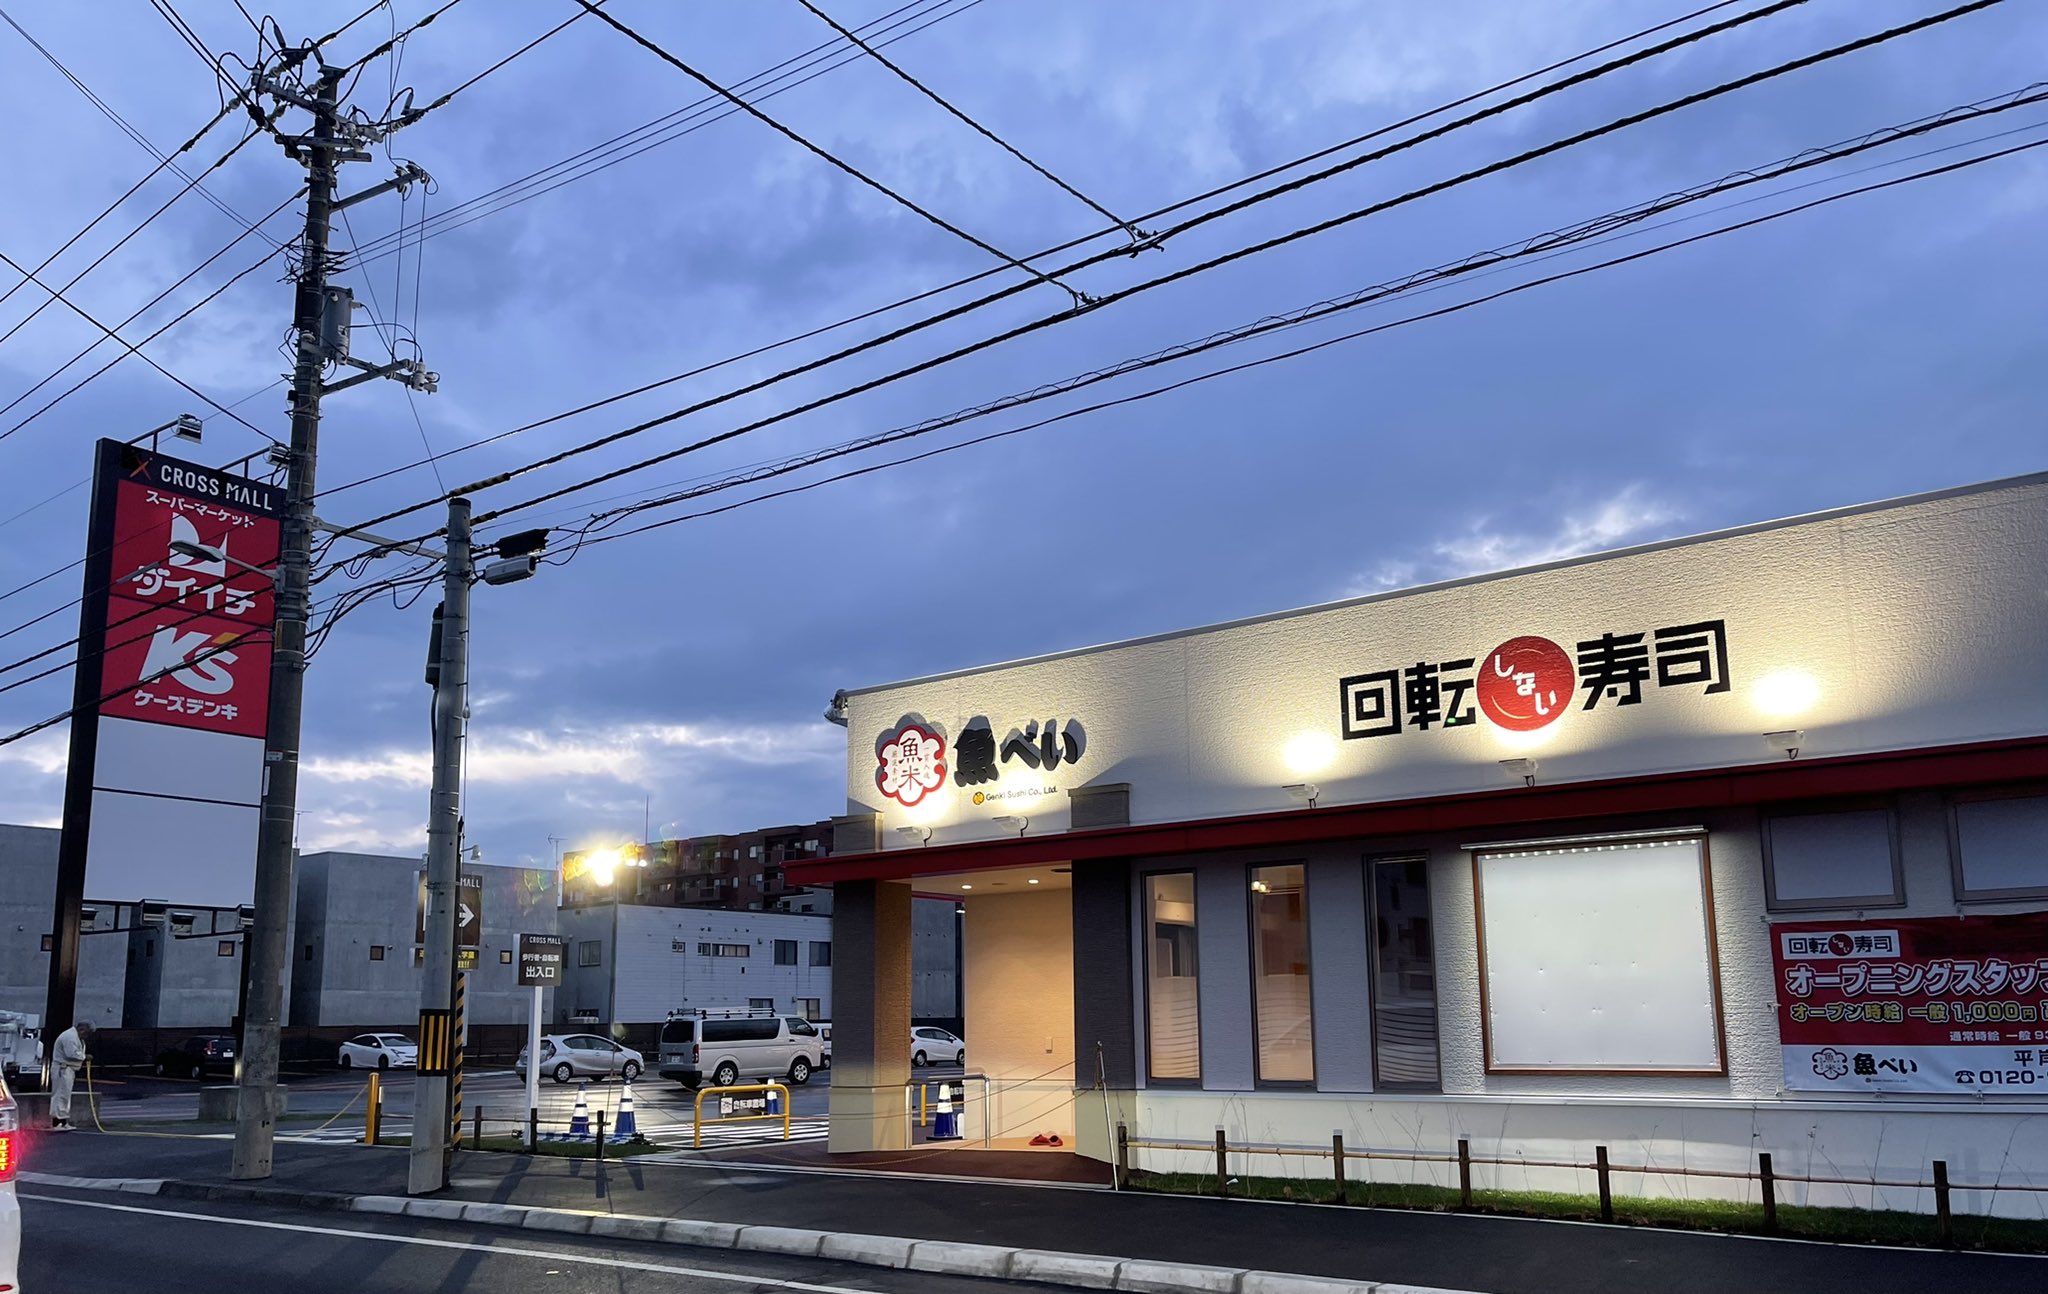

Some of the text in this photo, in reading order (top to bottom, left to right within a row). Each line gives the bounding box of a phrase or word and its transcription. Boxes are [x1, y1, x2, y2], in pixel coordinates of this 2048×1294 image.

[161, 465, 273, 511] CROSS MALL
[146, 490, 254, 528] スーパーマーケット
[131, 567, 256, 615] ダイイチ
[134, 689, 238, 721] ケーズデンキ
[986, 791, 1005, 800] Genki
[1007, 789, 1027, 799] Sushi
[460, 877, 480, 888] MALL
[529, 936, 561, 945] CROSS MALL
[525, 966, 555, 978] 出入口
[1786, 959, 2048, 997] オープニングスタッ
[1791, 1001, 1903, 1022] オープン時給
[1908, 1002, 1948, 1022] 一般
[1950, 1031, 2000, 1042] 通常時給
[1853, 1053, 1917, 1075] 魚べい
[1980, 1070, 2048, 1085] 0120-
